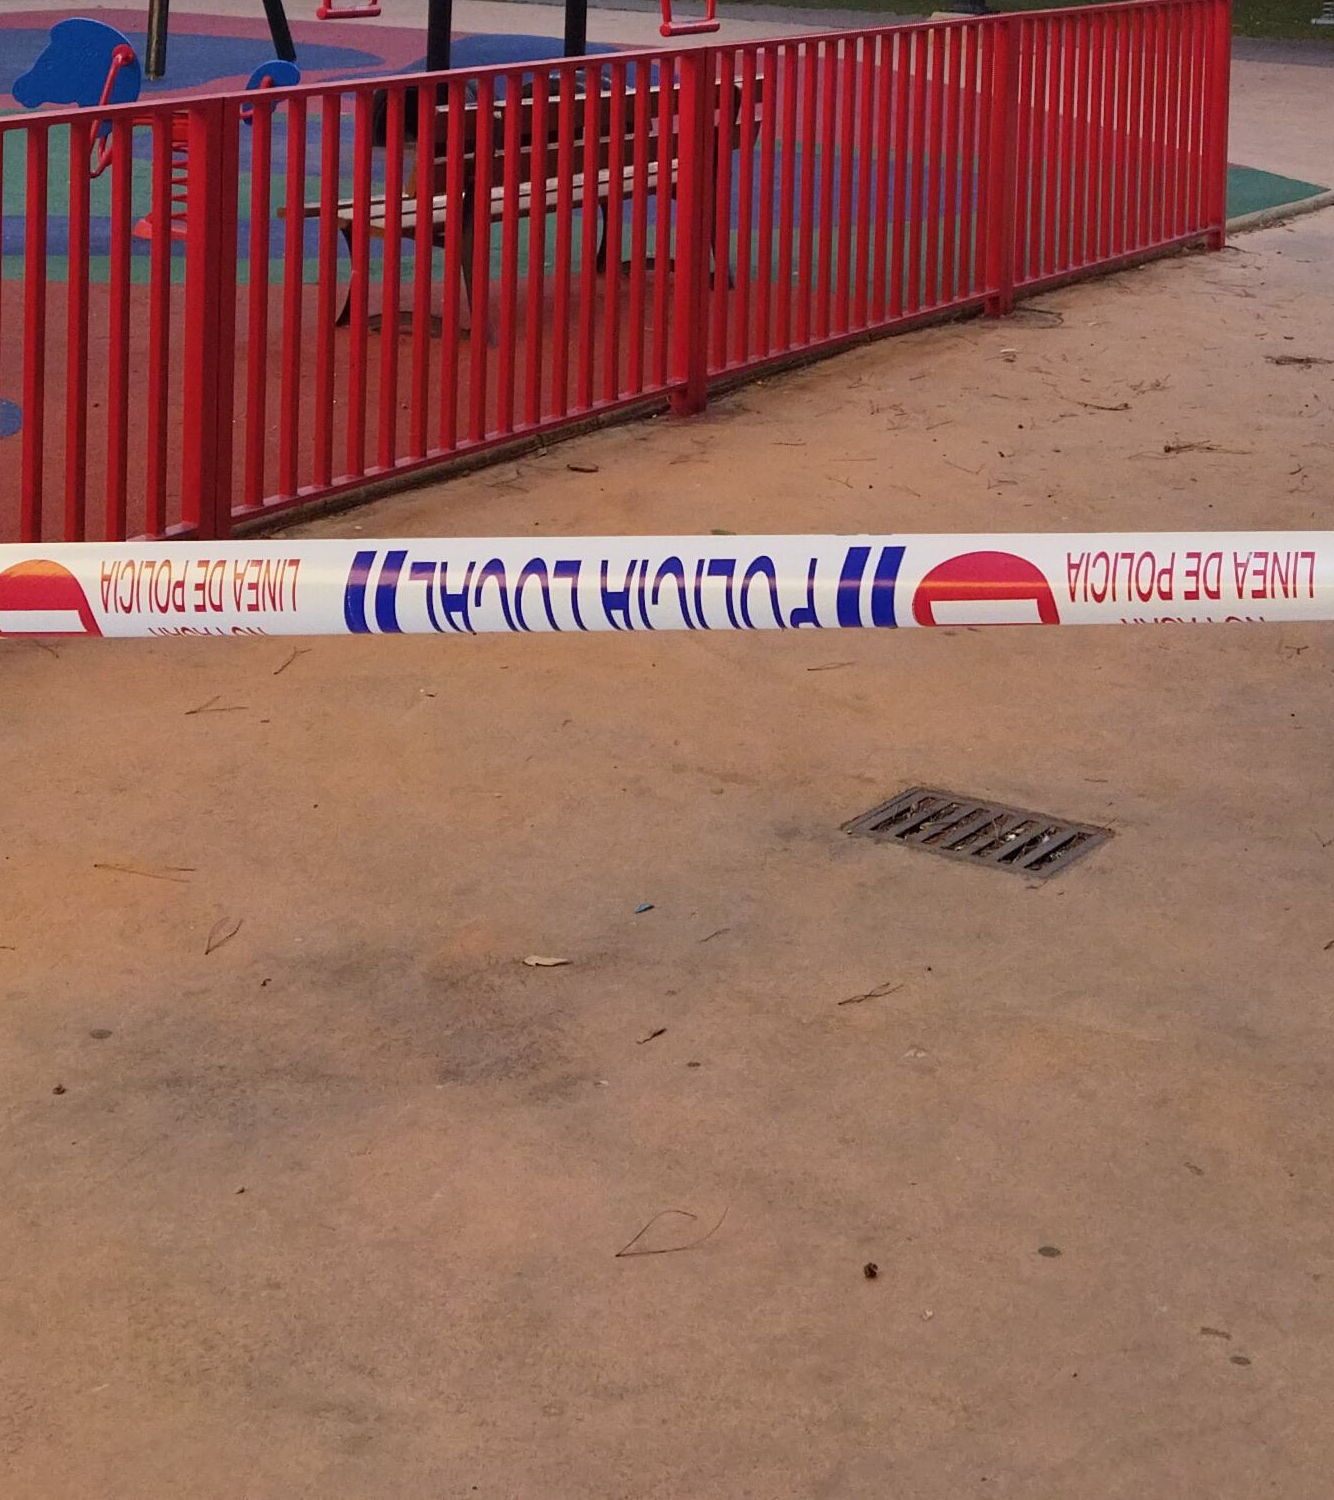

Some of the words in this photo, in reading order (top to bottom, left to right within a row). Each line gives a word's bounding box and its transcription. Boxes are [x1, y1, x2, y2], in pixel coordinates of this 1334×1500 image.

[100, 559, 189, 614] POLICIA
[194, 559, 227, 613] DE
[233, 558, 301, 612] LINEA
[408, 556, 589, 634] LOCAL
[601, 556, 824, 631] POLICIA
[1066, 551, 1177, 604] POLICIA
[1183, 551, 1224, 601] DE
[1232, 550, 1316, 600] LINEA
